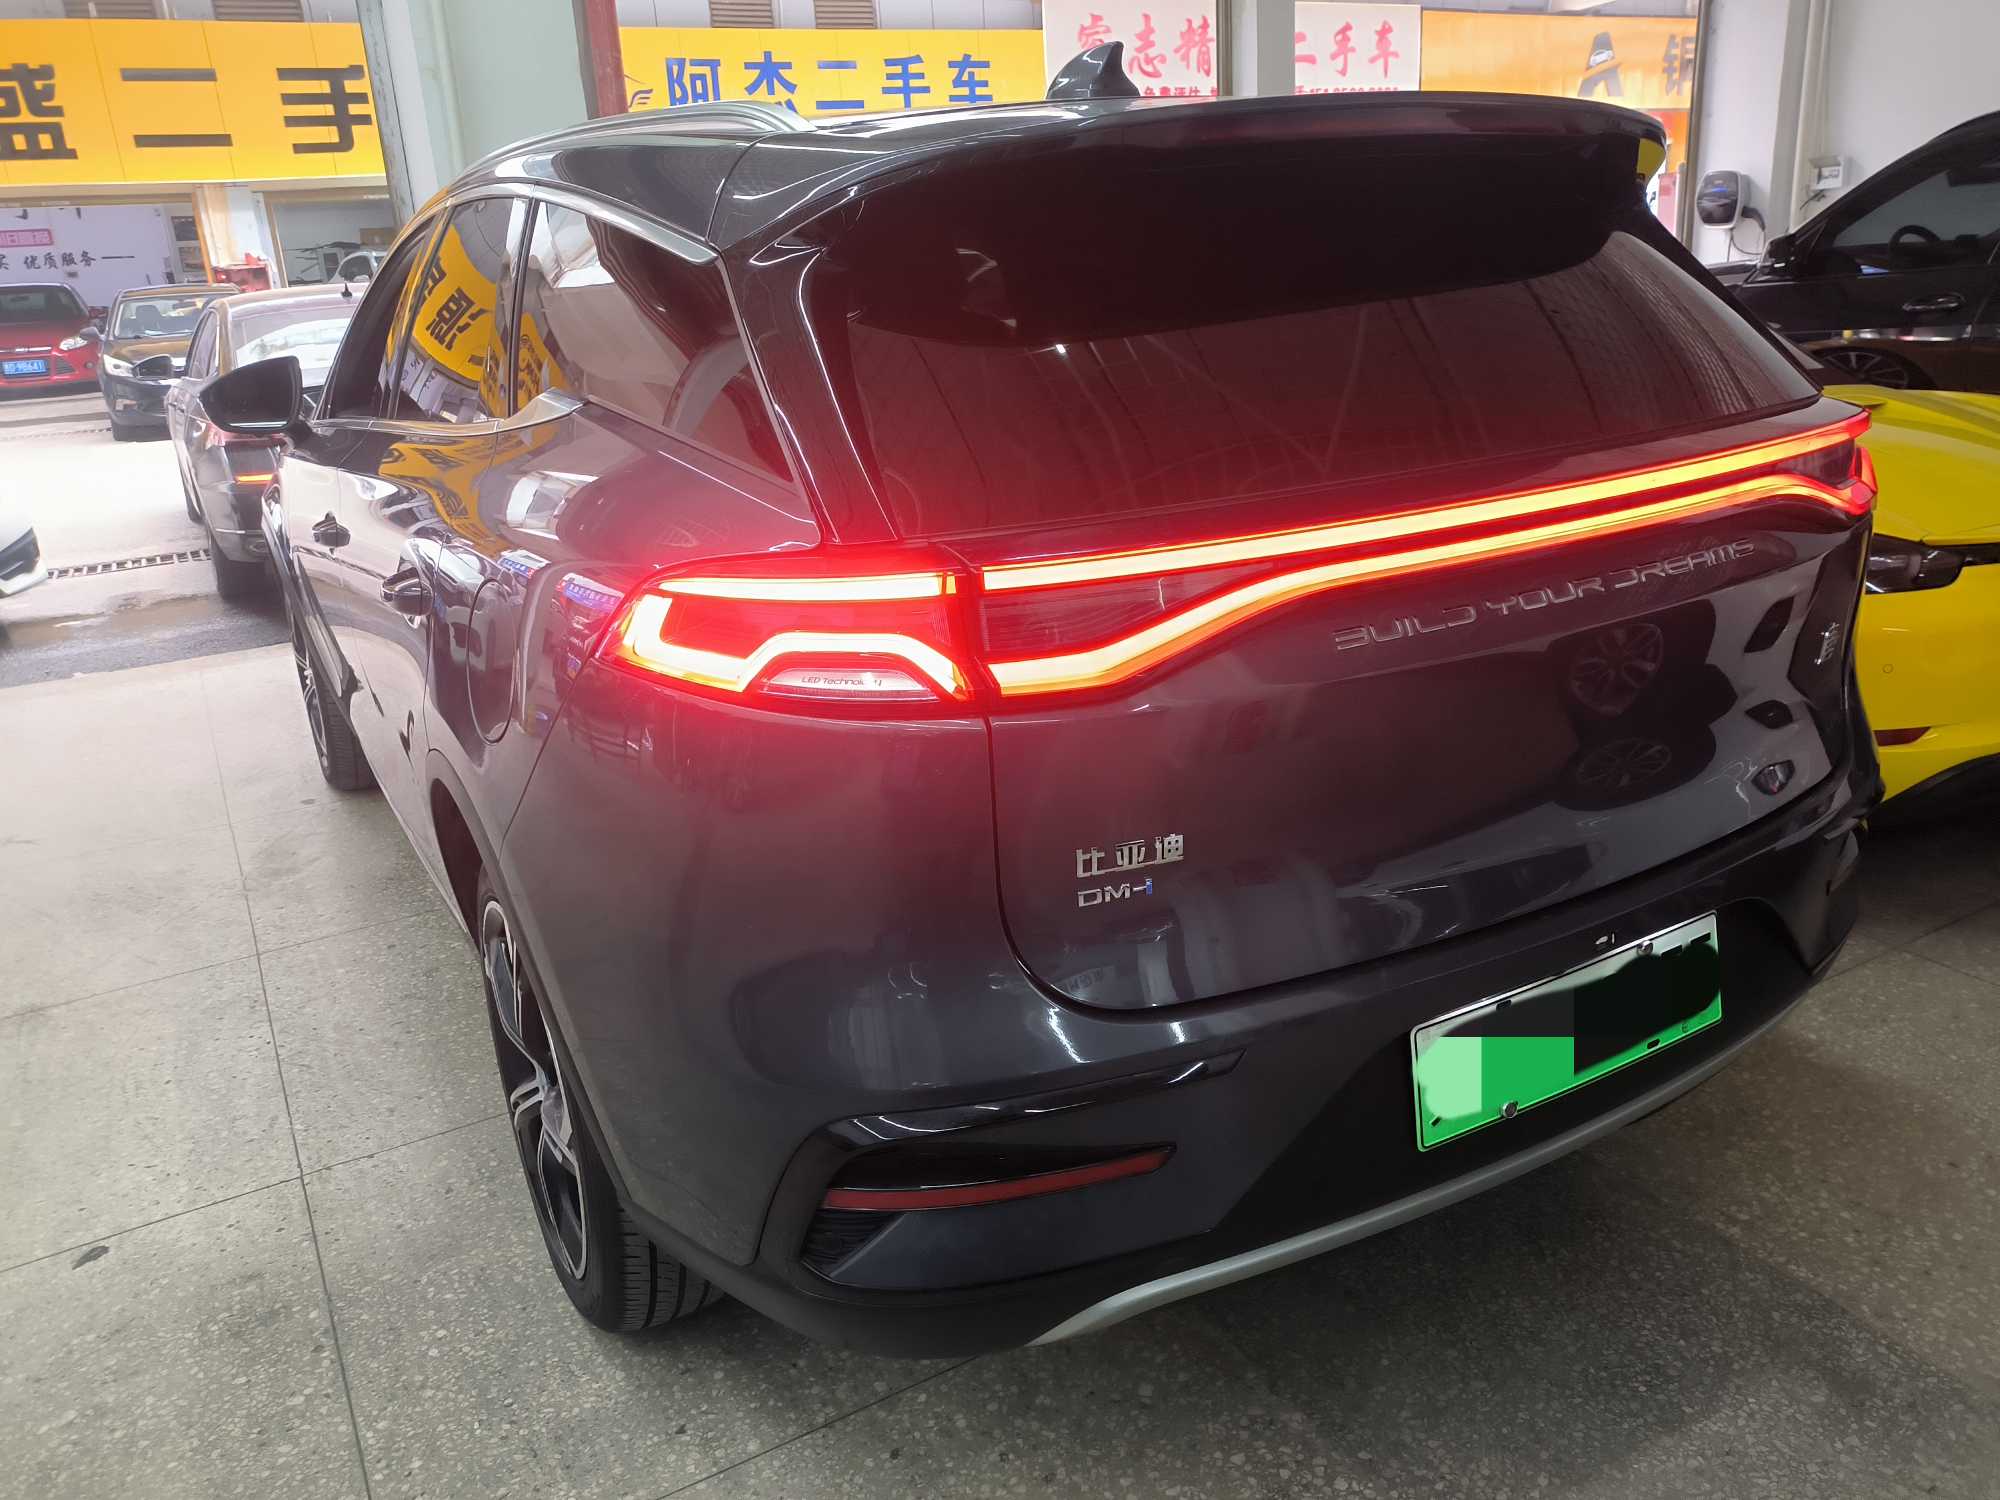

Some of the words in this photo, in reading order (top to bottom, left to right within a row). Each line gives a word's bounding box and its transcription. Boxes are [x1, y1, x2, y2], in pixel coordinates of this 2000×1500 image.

[665, 51, 994, 113] 阿杰二手车
[23, 250, 97, 270] 优质服务
[1332, 607, 1477, 652] BUILD
[1485, 577, 1605, 616] YOUR
[1613, 538, 1756, 589] DREAMS
[801, 676, 821, 684] LED
[823, 677, 882, 687] Technoly
[1076, 833, 1184, 878] 比亚迪
[1077, 878, 1153, 908] DM-i
